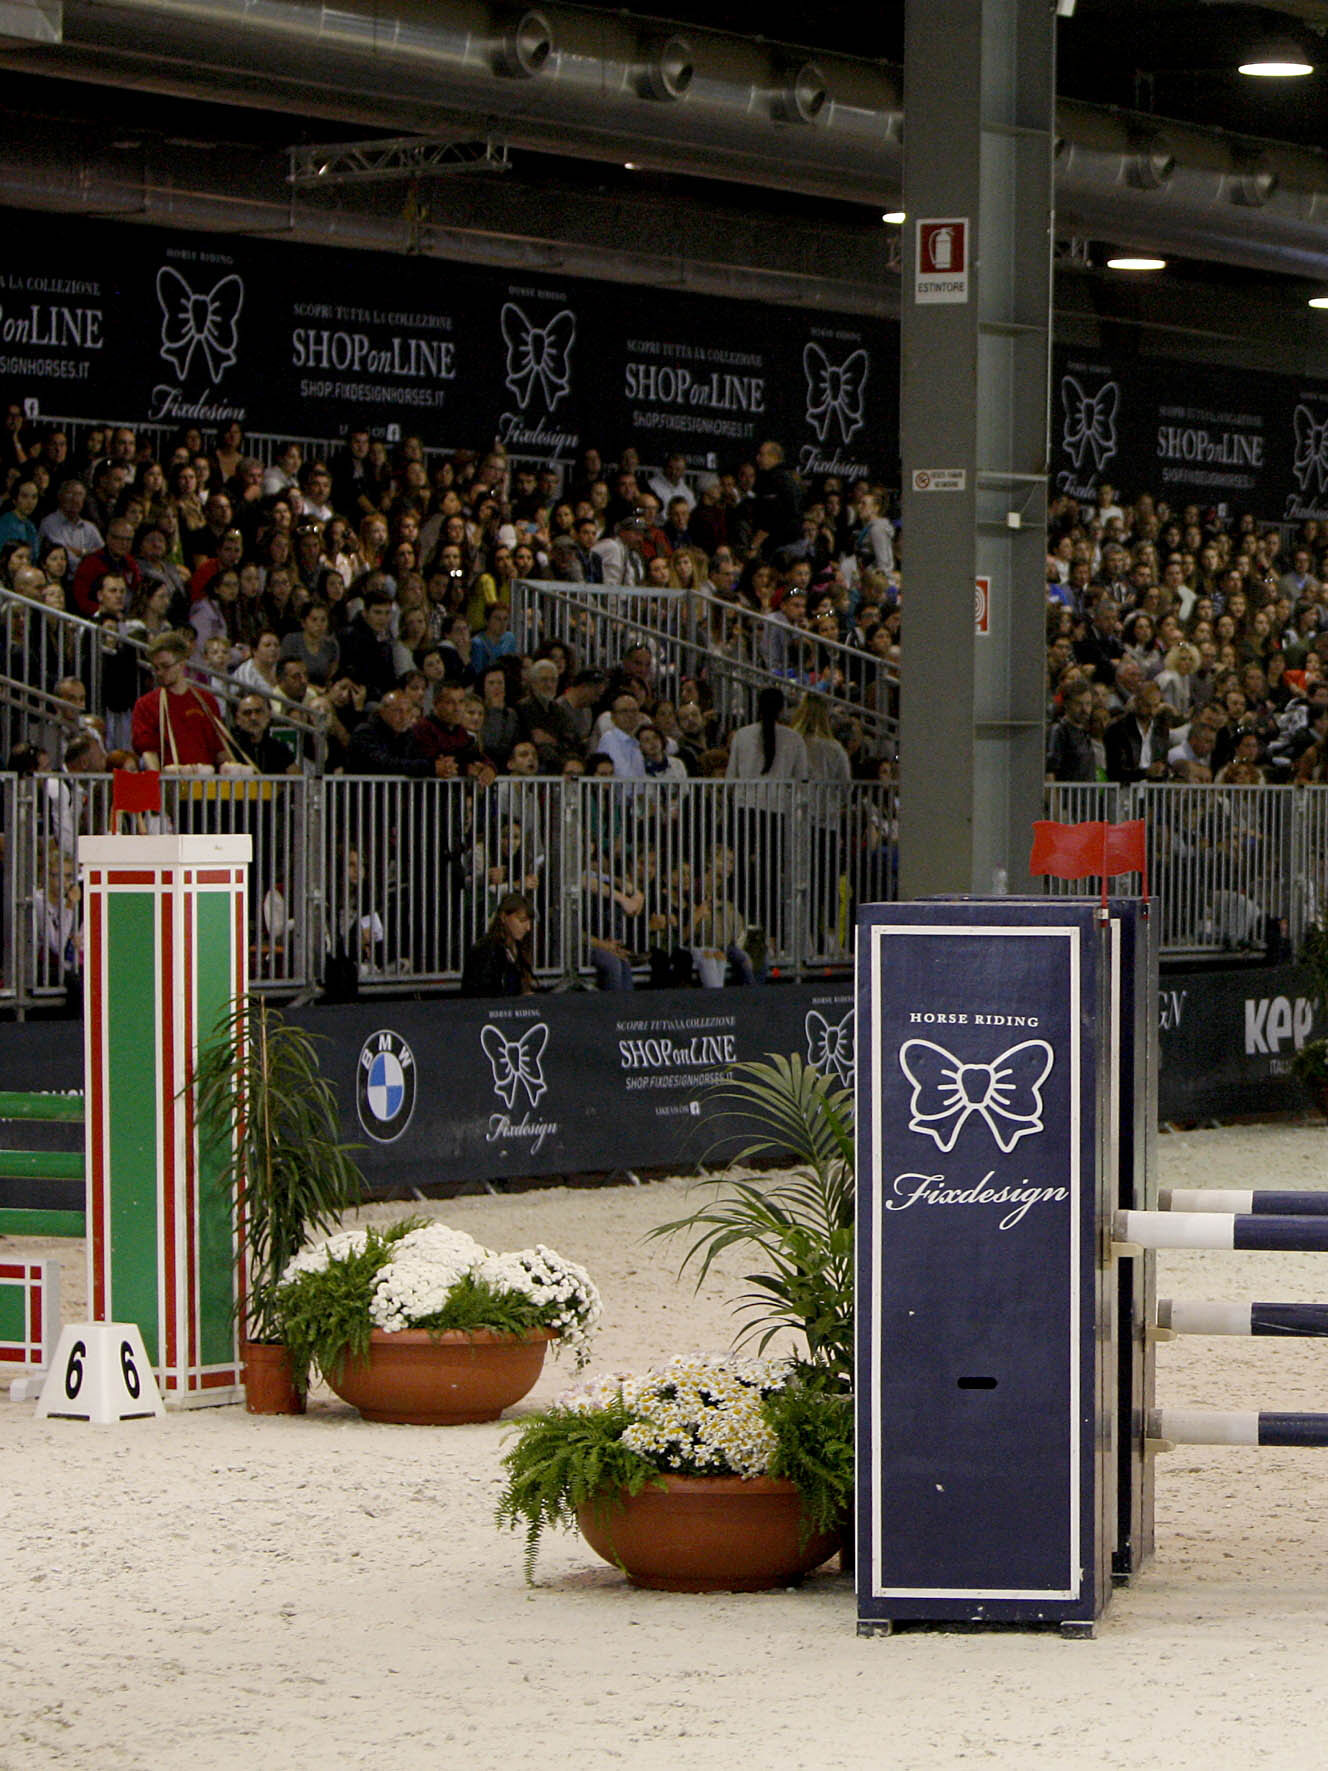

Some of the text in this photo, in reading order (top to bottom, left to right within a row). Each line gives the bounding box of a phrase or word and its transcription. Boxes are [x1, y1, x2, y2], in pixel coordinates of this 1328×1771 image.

[918, 281, 965, 293] ESTINTORE
[909, 1012, 1039, 1028] HORSE RIDING
[361, 1033, 411, 1071] BMW
[486, 1111, 558, 1155] Fixdesign
[886, 1171, 1069, 1230] Fixdesign
[65, 1340, 86, 1400] 6
[120, 1340, 140, 1399] 6
